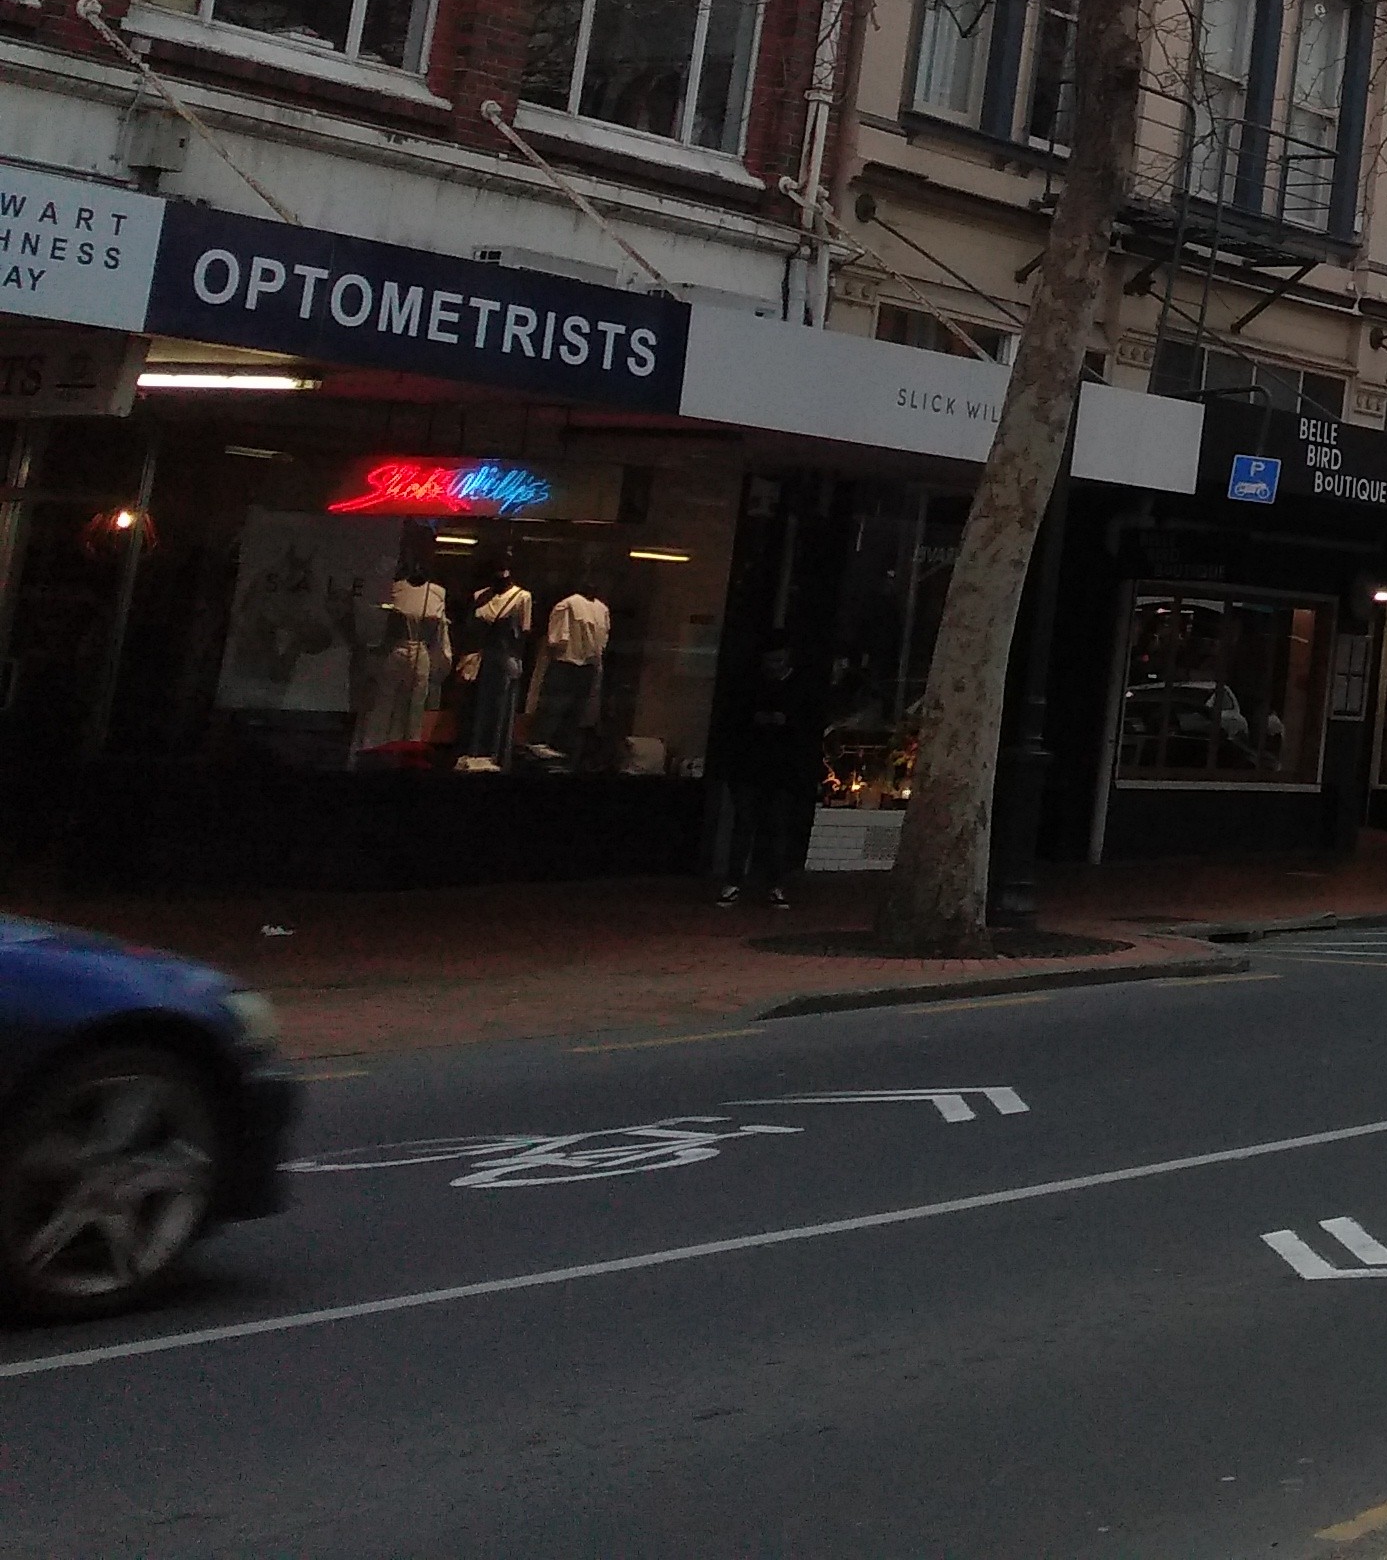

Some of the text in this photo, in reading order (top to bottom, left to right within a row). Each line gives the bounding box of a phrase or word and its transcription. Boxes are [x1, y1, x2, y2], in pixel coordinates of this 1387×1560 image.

[0, 192, 128, 236] WART
[192, 248, 658, 378] OPTOMETRISTS
[896, 387, 956, 416] SLICK
[1299, 417, 1339, 446] BELLE
[1249, 460, 1266, 477] P
[1306, 443, 1342, 471] BIRD
